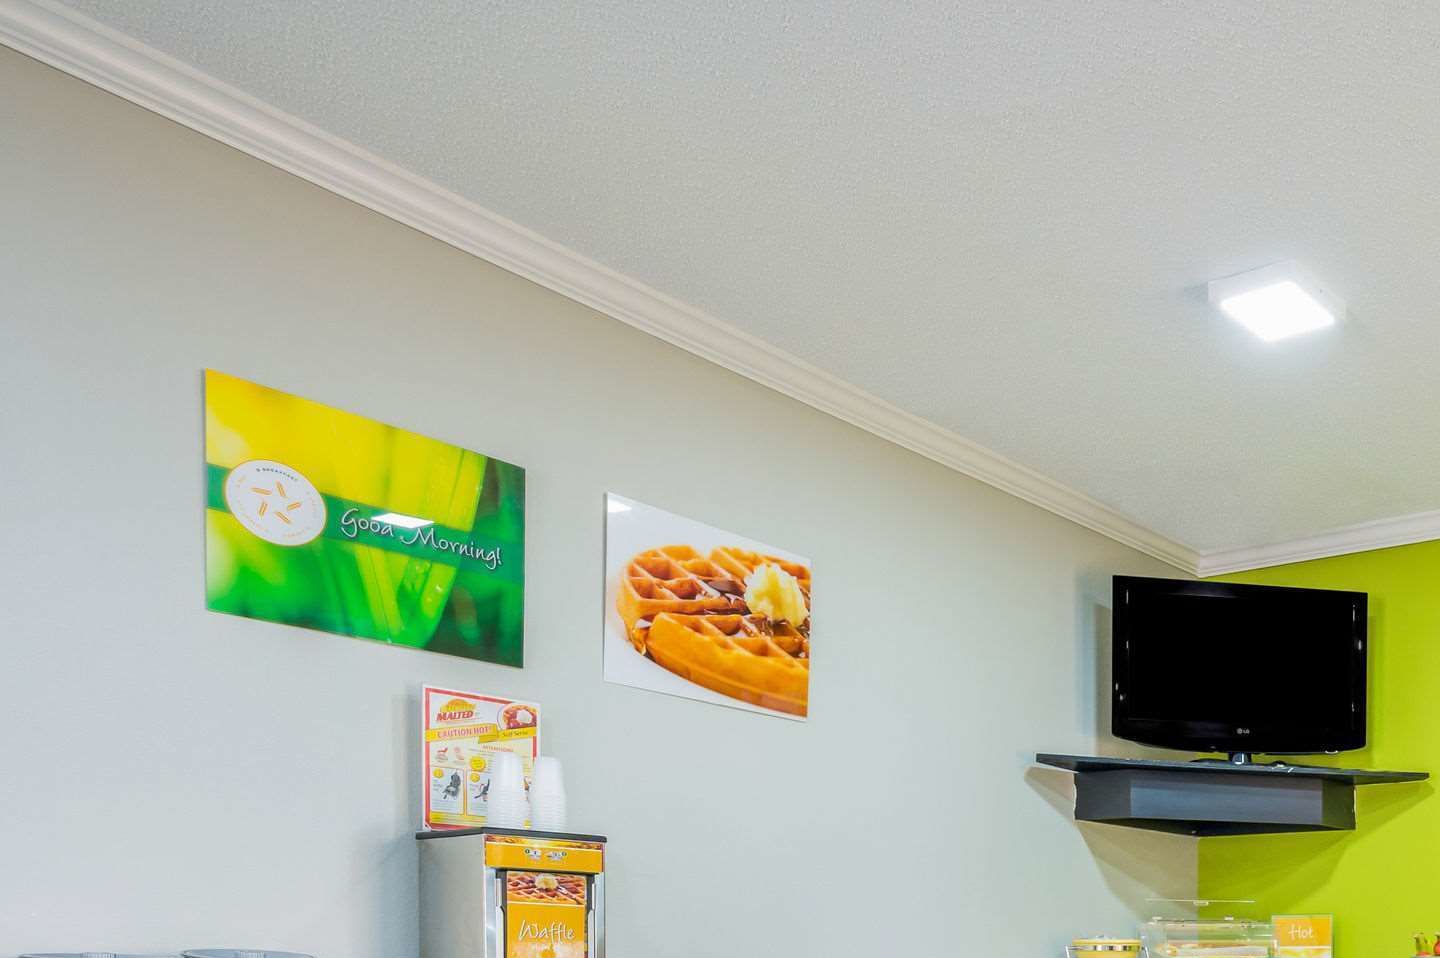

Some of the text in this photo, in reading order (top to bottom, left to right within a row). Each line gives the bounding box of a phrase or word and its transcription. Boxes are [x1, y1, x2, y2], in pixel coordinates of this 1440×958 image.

[341, 508, 502, 570] Good Morning!
[518, 919, 576, 944] Waffle
[1287, 924, 1314, 941] Hot
